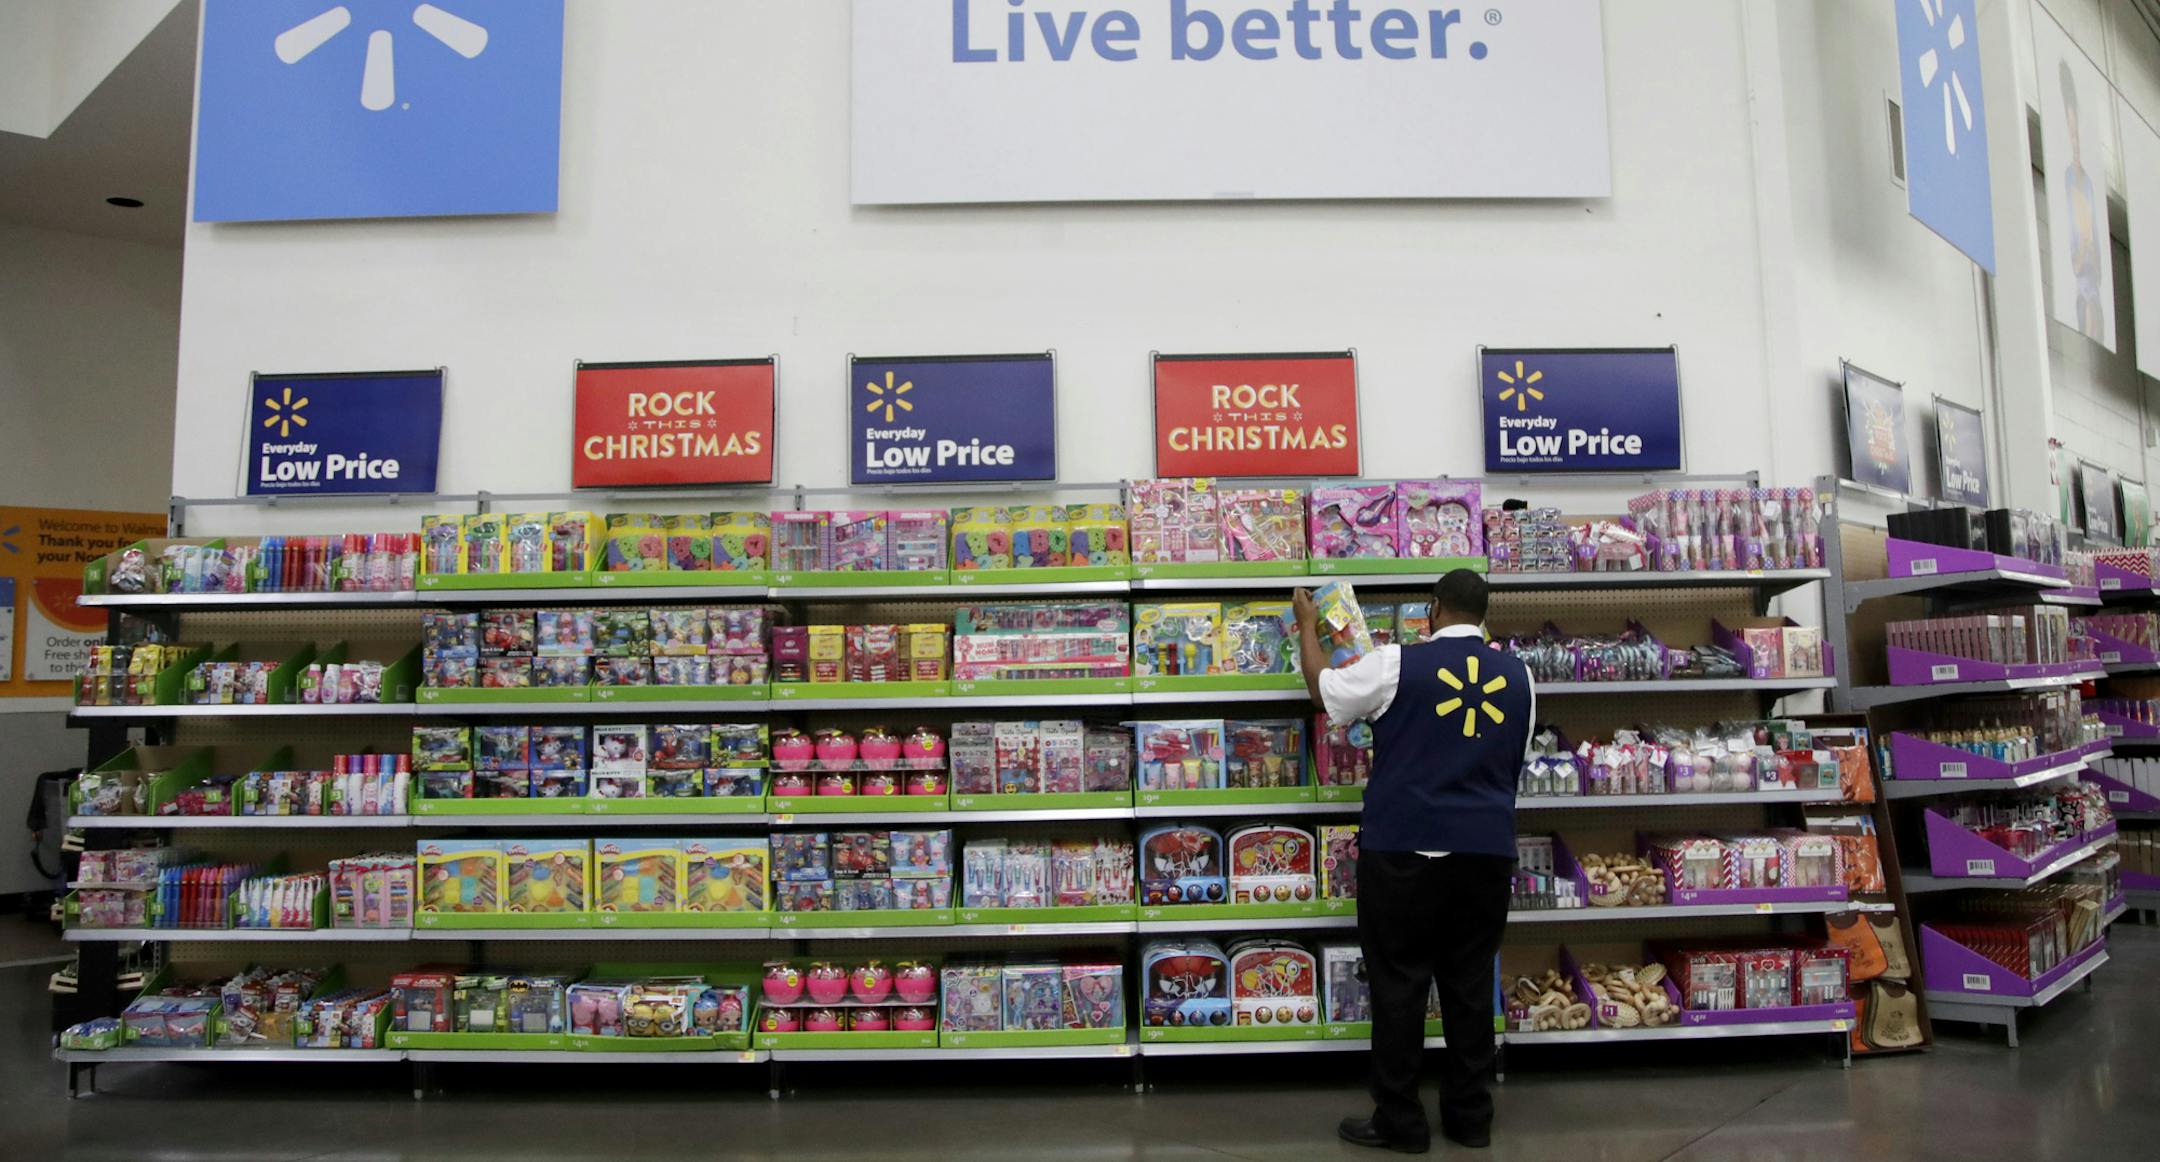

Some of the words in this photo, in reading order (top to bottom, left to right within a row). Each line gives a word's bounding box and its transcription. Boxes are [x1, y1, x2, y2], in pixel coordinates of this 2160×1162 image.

[952, 0, 1141, 64] Live
[1211, 384, 1301, 409] ROCK
[628, 390, 716, 417] ROCK
[1228, 412, 1287, 422] THIS
[1499, 415, 1557, 430] Everyday
[642, 419, 701, 429] THIS
[866, 427, 926, 442] Everyday
[1168, 424, 1348, 451] CHRISTMAS
[583, 430, 761, 460] CHRISTMAS
[1499, 430, 1563, 456] Low
[1568, 428, 1643, 455] Price
[262, 441, 318, 455] Everyday
[866, 441, 931, 468] Low
[937, 438, 1015, 466] Price
[260, 455, 321, 482] Low
[326, 452, 400, 480] Price
[1946, 466, 1962, 490] Low
[1962, 470, 1980, 494] Price
[38, 519, 102, 532] Welcome
[106, 524, 119, 534] to
[38, 534, 83, 547] Thank
[87, 538, 114, 550] you
[1496, 549, 1505, 557] $1
[1582, 547, 1591, 555] $1
[1667, 545, 1676, 553] $3
[1748, 544, 1758, 553] $3
[37, 552, 70, 564] your
[46, 636, 81, 647] Order
[45, 649, 70, 660] Free
[50, 664, 64, 673] to
[1588, 659, 1597, 668] $1
[1593, 768, 1602, 777] $1
[1680, 767, 1689, 776] $3
[1766, 772, 1777, 781] $3
[1594, 884, 1603, 893] $1
[1515, 1009, 1524, 1018] $1
[1605, 1006, 1613, 1016] $1
